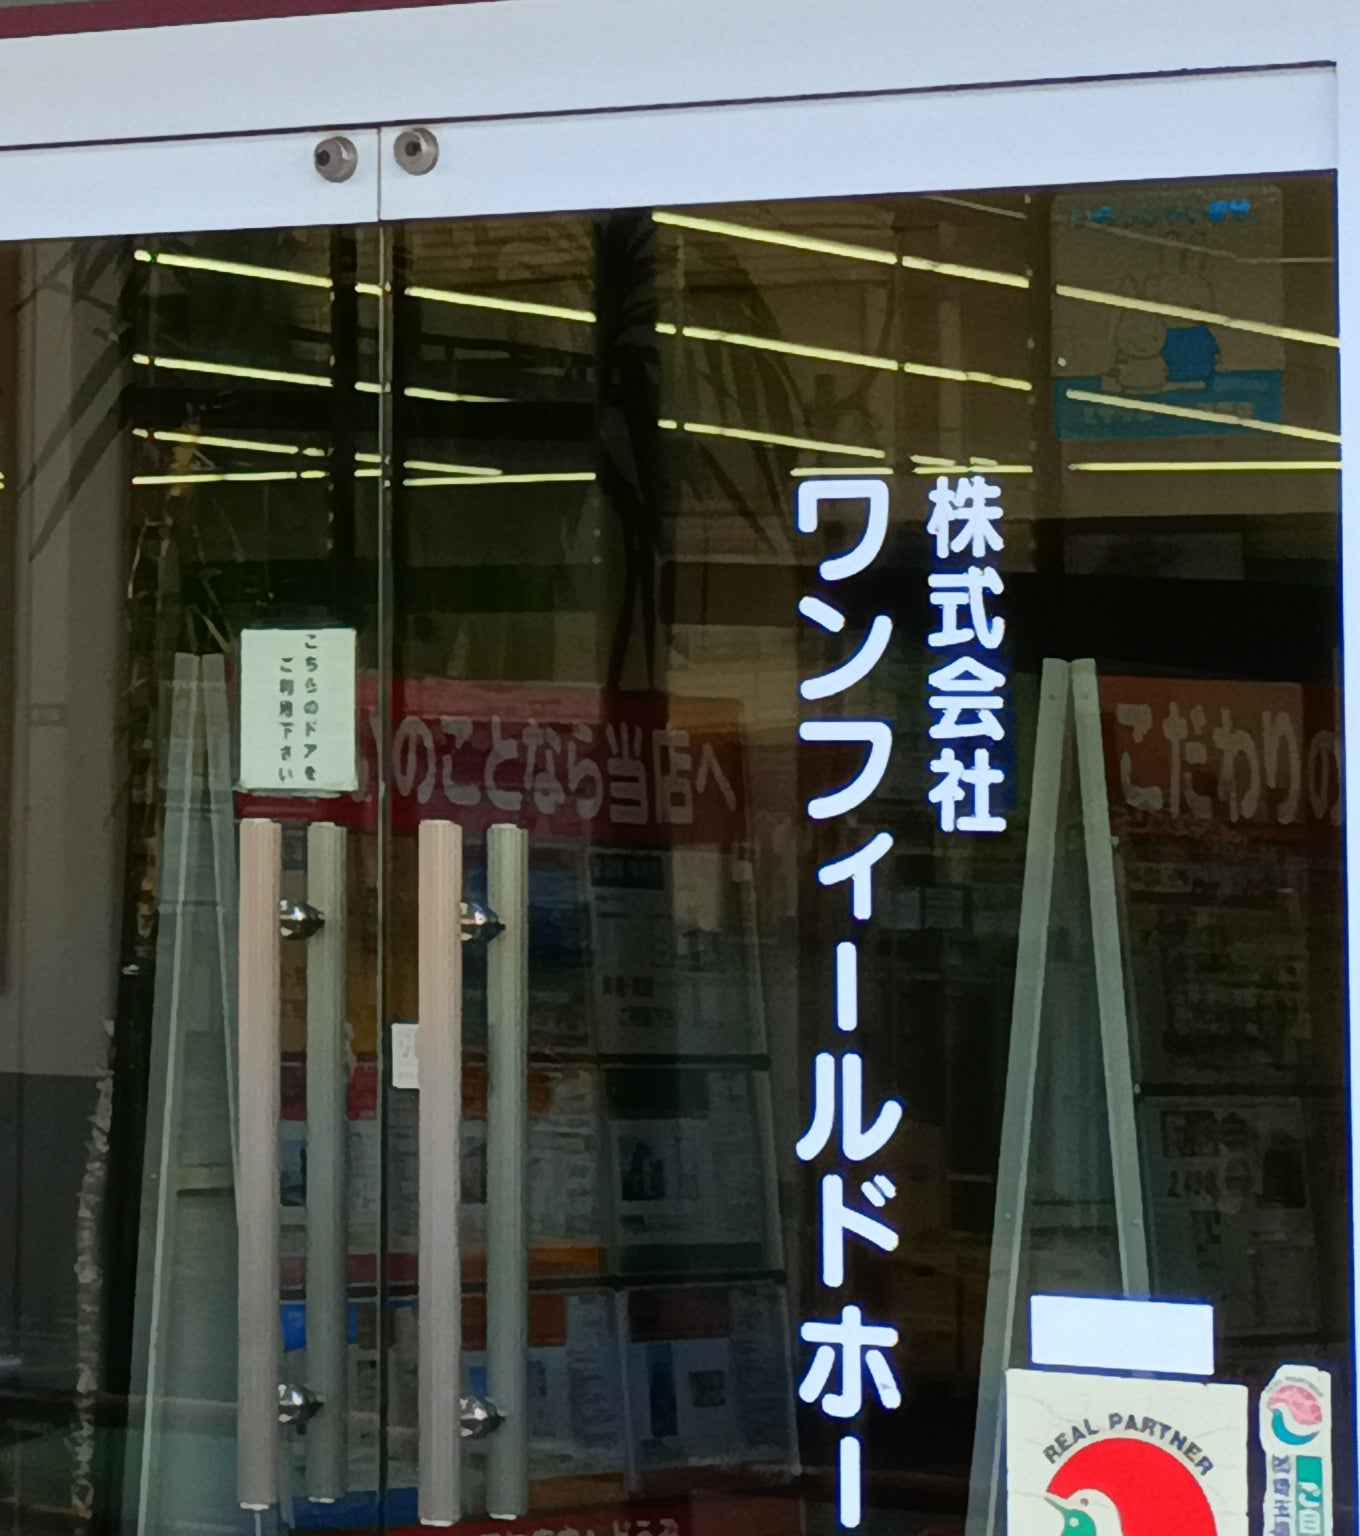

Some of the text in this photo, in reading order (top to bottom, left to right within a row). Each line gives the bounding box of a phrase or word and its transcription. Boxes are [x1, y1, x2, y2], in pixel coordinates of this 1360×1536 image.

[927, 474, 1008, 834] 株式会社
[794, 478, 905, 1529] ワンフィールドホー
[1042, 1411, 1214, 1477] REAL PARTNER
